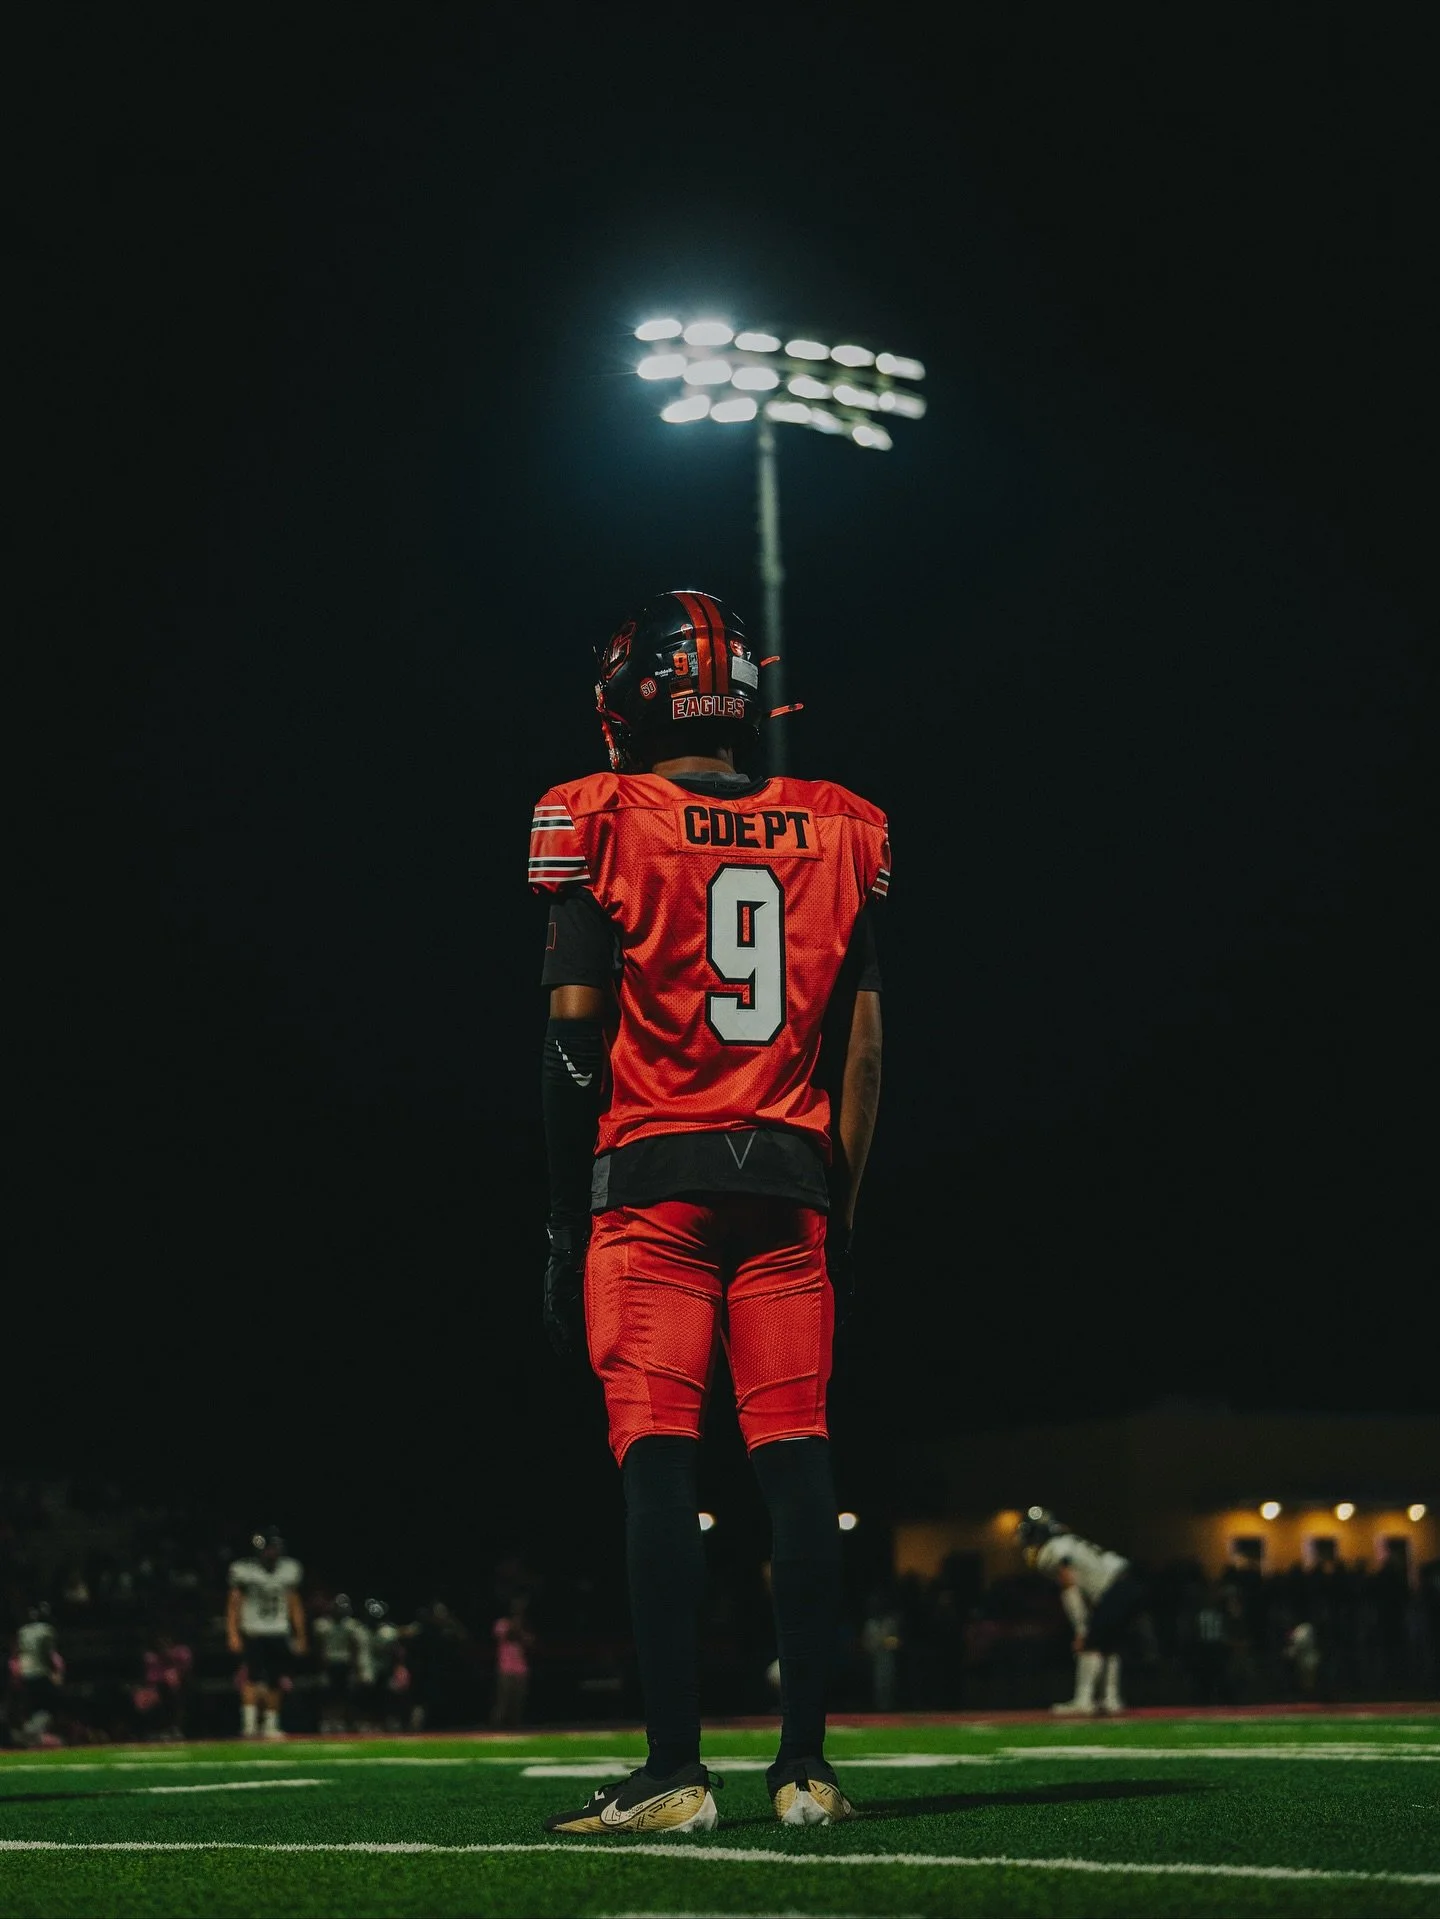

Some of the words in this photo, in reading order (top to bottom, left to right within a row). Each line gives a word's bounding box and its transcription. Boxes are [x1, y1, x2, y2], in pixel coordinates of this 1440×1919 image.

[672, 652, 689, 676] 9
[672, 695, 744, 720] EAGLES
[684, 805, 810, 849] CDEPT
[704, 862, 787, 1047] 9
